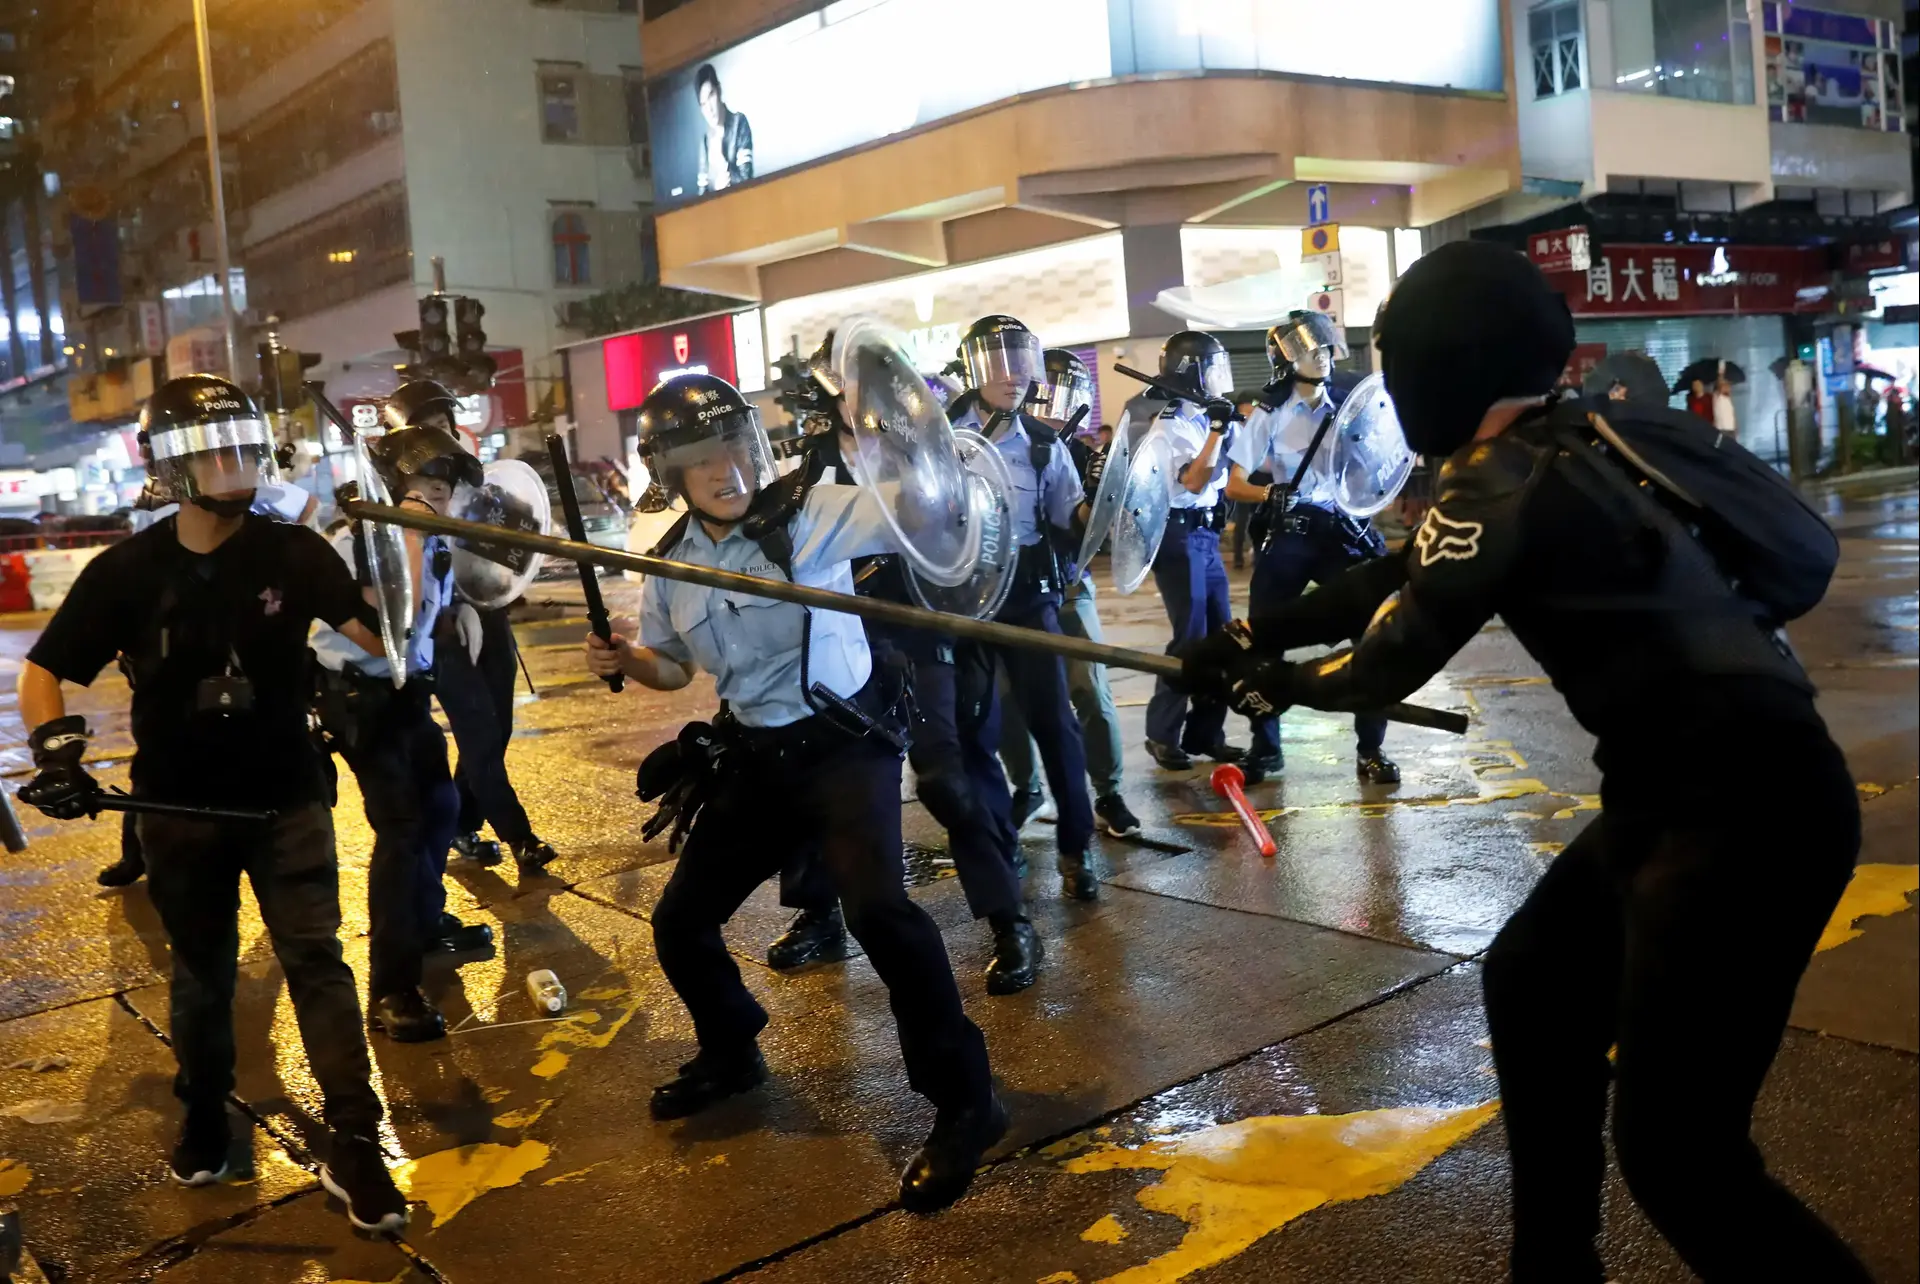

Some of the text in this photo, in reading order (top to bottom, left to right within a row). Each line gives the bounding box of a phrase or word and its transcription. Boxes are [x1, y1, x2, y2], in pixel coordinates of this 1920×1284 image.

[1586, 256, 1679, 302] 周大福
[203, 399, 241, 412] Police
[698, 404, 733, 421] Police
[749, 563, 778, 573] POLICE
